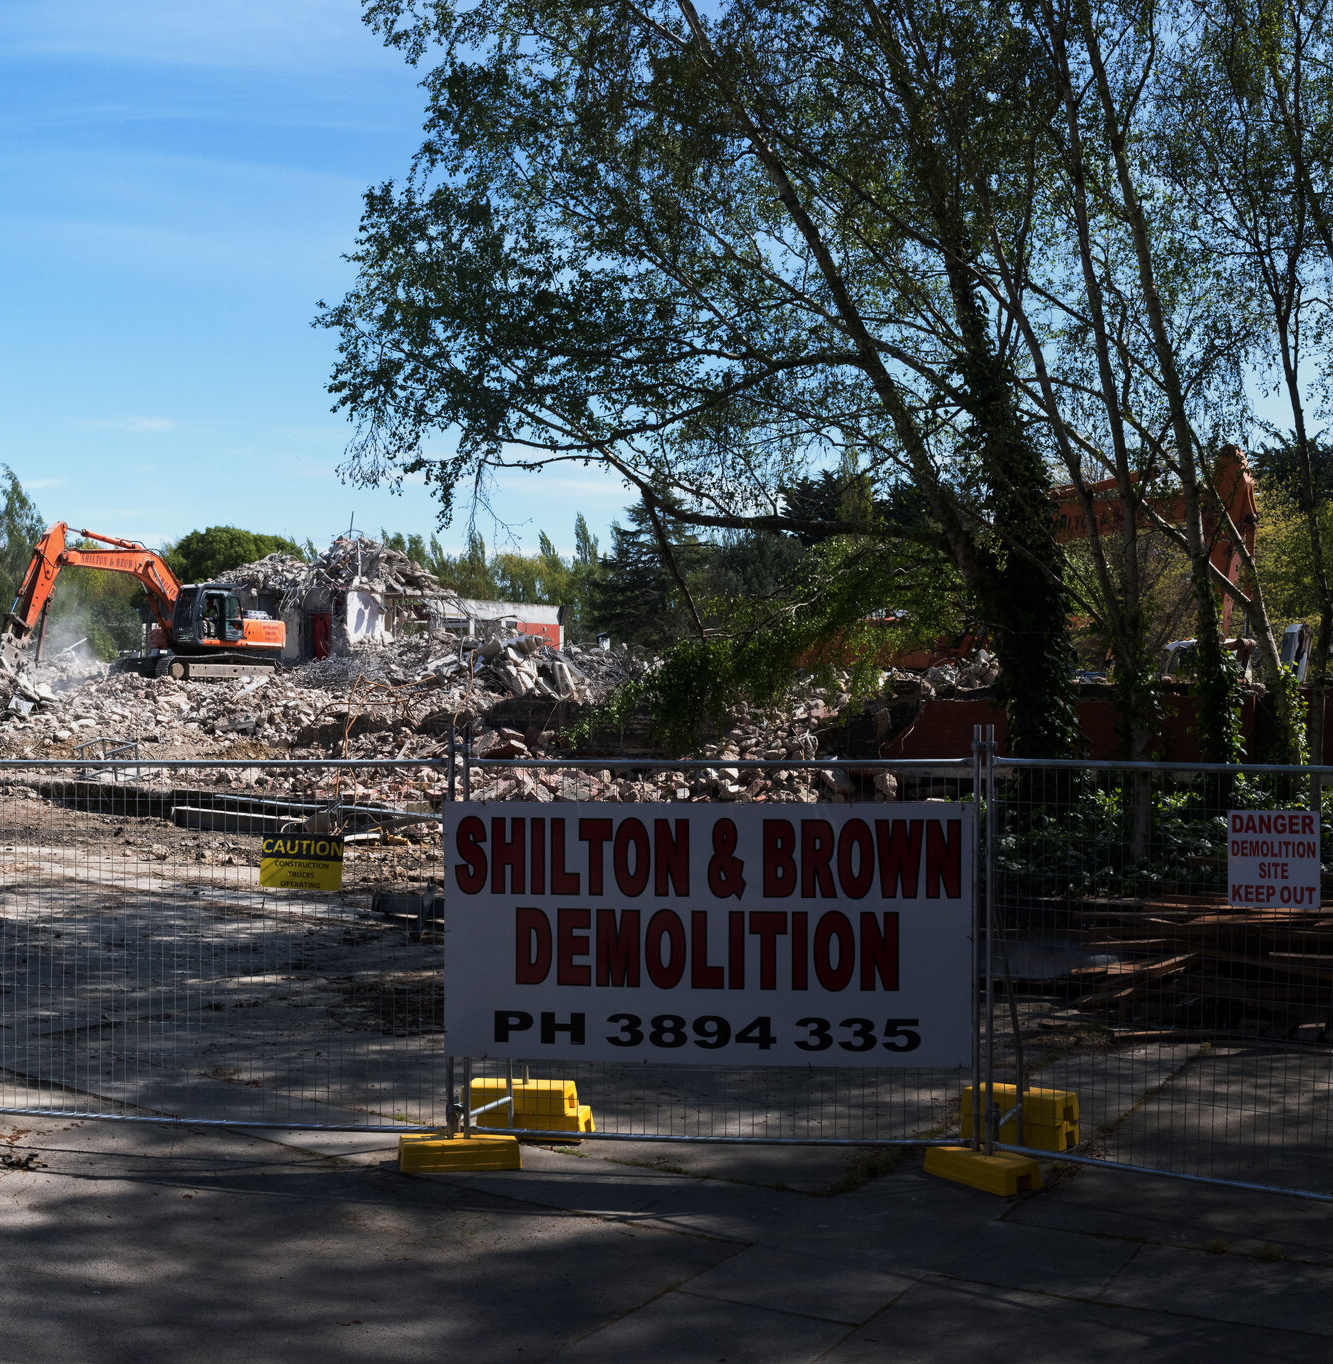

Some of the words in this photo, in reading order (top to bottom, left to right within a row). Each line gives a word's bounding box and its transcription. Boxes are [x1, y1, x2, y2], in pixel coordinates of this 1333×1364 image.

[81, 554, 107, 565] SHILTON
[1232, 814, 1315, 834] DANGER
[263, 839, 343, 857] CAUTION
[1231, 840, 1316, 858] DEMOLITION
[275, 860, 329, 869] CONSTRUCTION
[455, 816, 690, 897] SHILTON
[707, 816, 747, 900] &
[763, 818, 961, 900] BROWN
[288, 871, 315, 879] TRUCKS
[1259, 862, 1289, 879] SITE
[280, 881, 321, 889] OPERATING
[1232, 884, 1276, 903] KEEP
[1280, 886, 1316, 904] OUT
[515, 907, 899, 992] DEMOLITION
[493, 1010, 585, 1045] PH
[605, 1013, 777, 1050] 3894
[794, 1017, 921, 1052] 335
